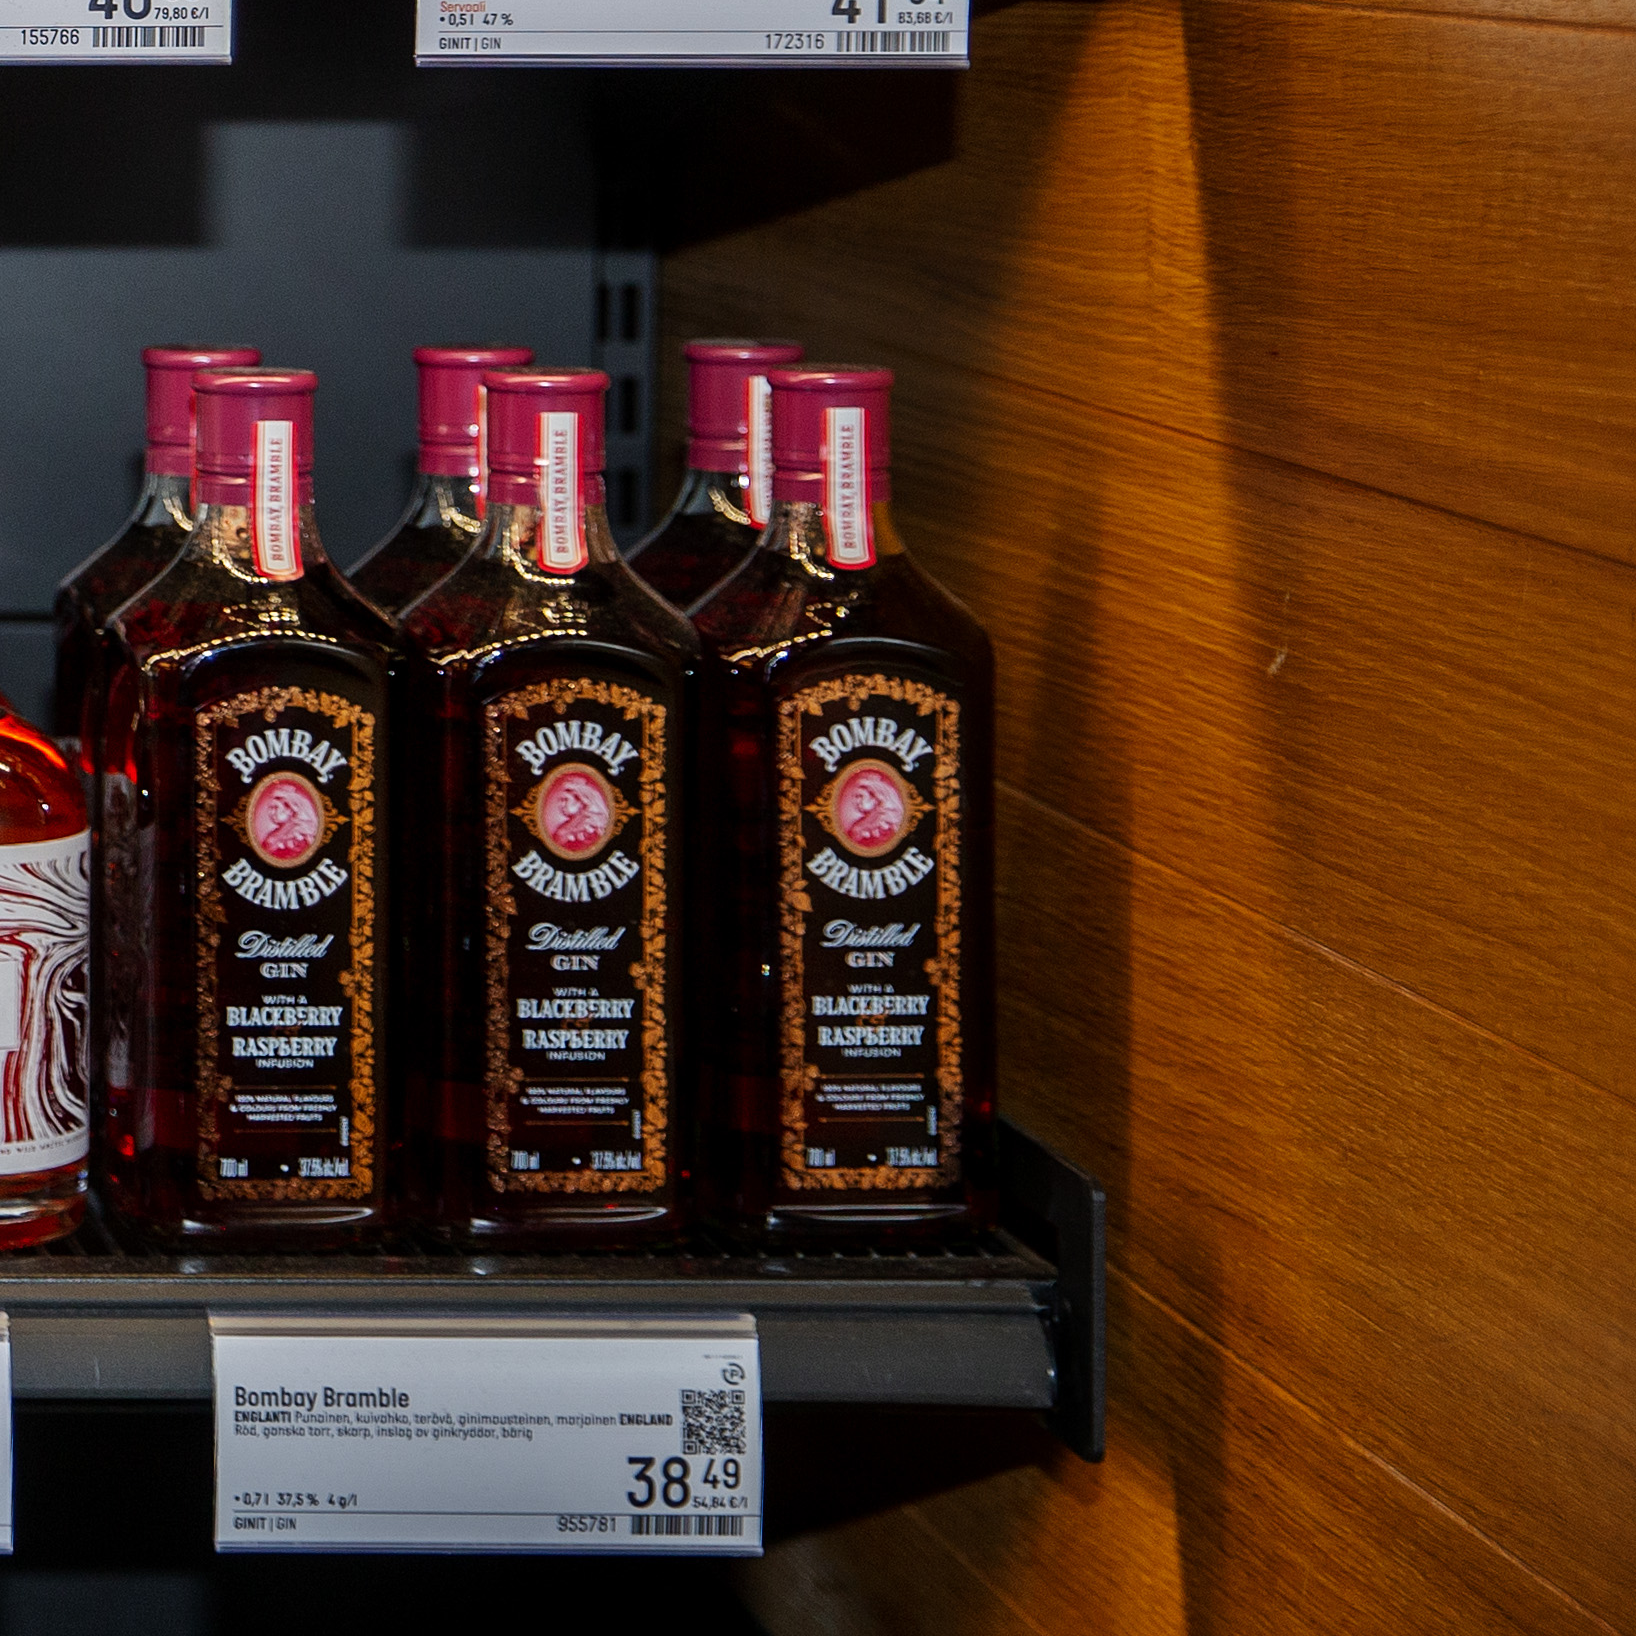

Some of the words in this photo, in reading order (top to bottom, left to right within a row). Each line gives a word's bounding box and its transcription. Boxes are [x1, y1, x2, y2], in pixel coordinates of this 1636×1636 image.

[21, 29, 79, 45] 155766
[515, 721, 639, 775] BOMBAY
[512, 850, 639, 901] BRAMBLE
[527, 923, 626, 952] Distilled
[550, 953, 598, 971] GIN
[517, 998, 634, 1021] BLACKBERRY
[523, 1029, 629, 1051] RASPBERRY
[235, 1386, 317, 1411] Bombay
[324, 1387, 409, 1408] Bramble
[627, 1456, 690, 1508] 38
[702, 1458, 740, 1489] 49
